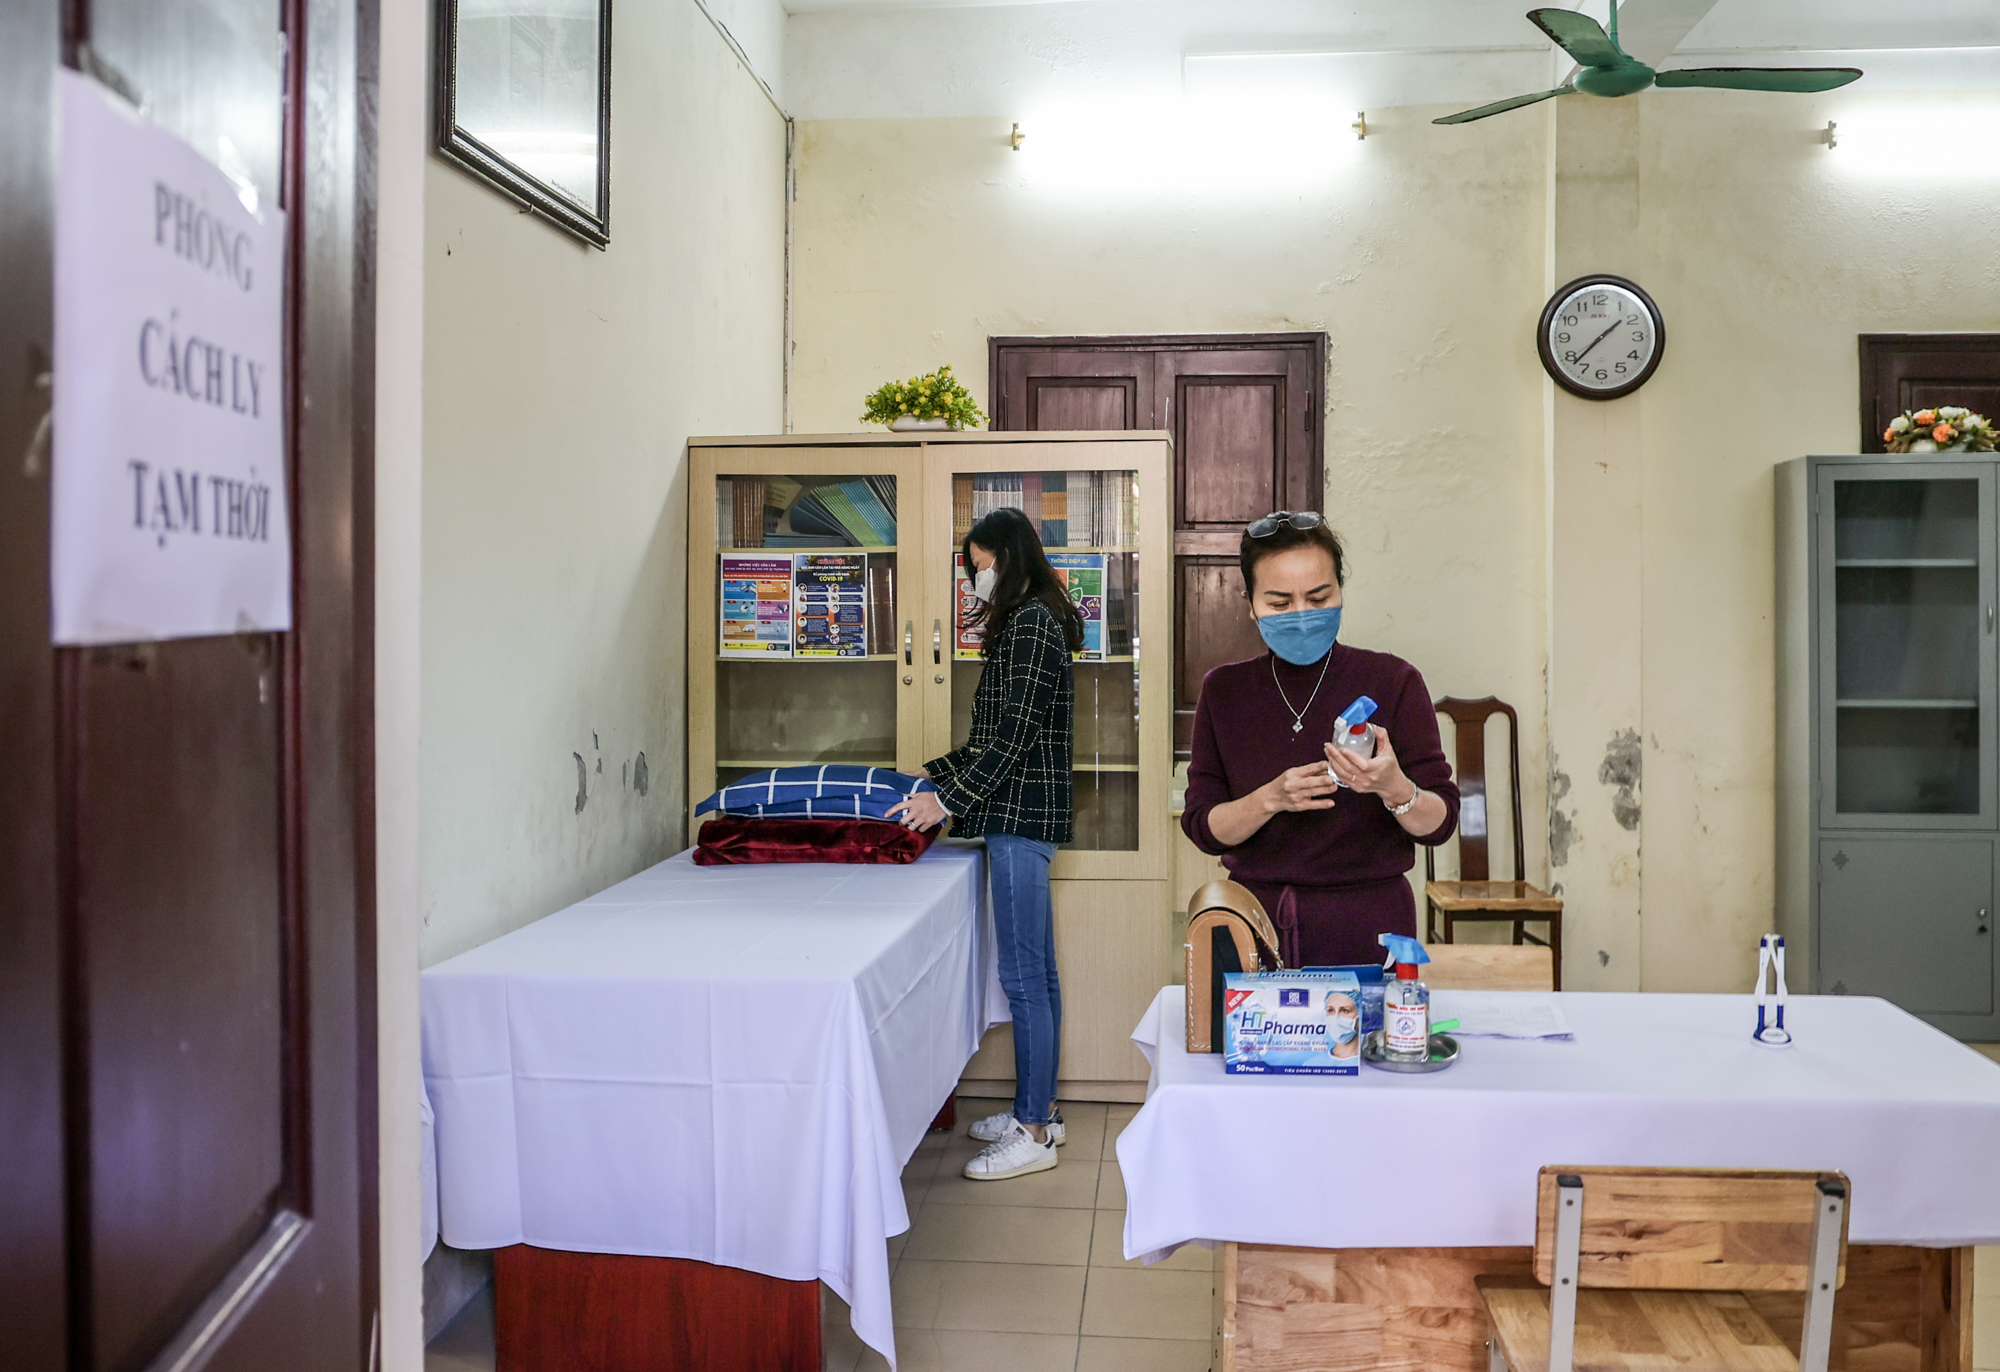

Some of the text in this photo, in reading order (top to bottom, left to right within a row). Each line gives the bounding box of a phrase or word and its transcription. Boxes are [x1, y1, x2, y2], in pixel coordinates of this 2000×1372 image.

[1592, 294, 1609, 306] 12
[1576, 301, 1588, 313] 11
[1617, 301, 1622, 312] 1
[1562, 315, 1579, 327] 10
[1626, 313, 1639, 326] 2
[1558, 332, 1571, 344] 9
[1631, 330, 1644, 342] 3
[1564, 350, 1577, 362] 8
[1627, 349, 1640, 361] 4
[139, 307, 265, 420] CÁCH LY
[1578, 363, 1590, 375] 7
[1614, 361, 1627, 374] 5
[1595, 368, 1608, 380] 6
[128, 459, 270, 550] TẠM THỜI
[1228, 991, 1245, 1008] NEW!
[1241, 1011, 1327, 1035] HT Pharma
[1236, 1064, 1246, 1072] 50
